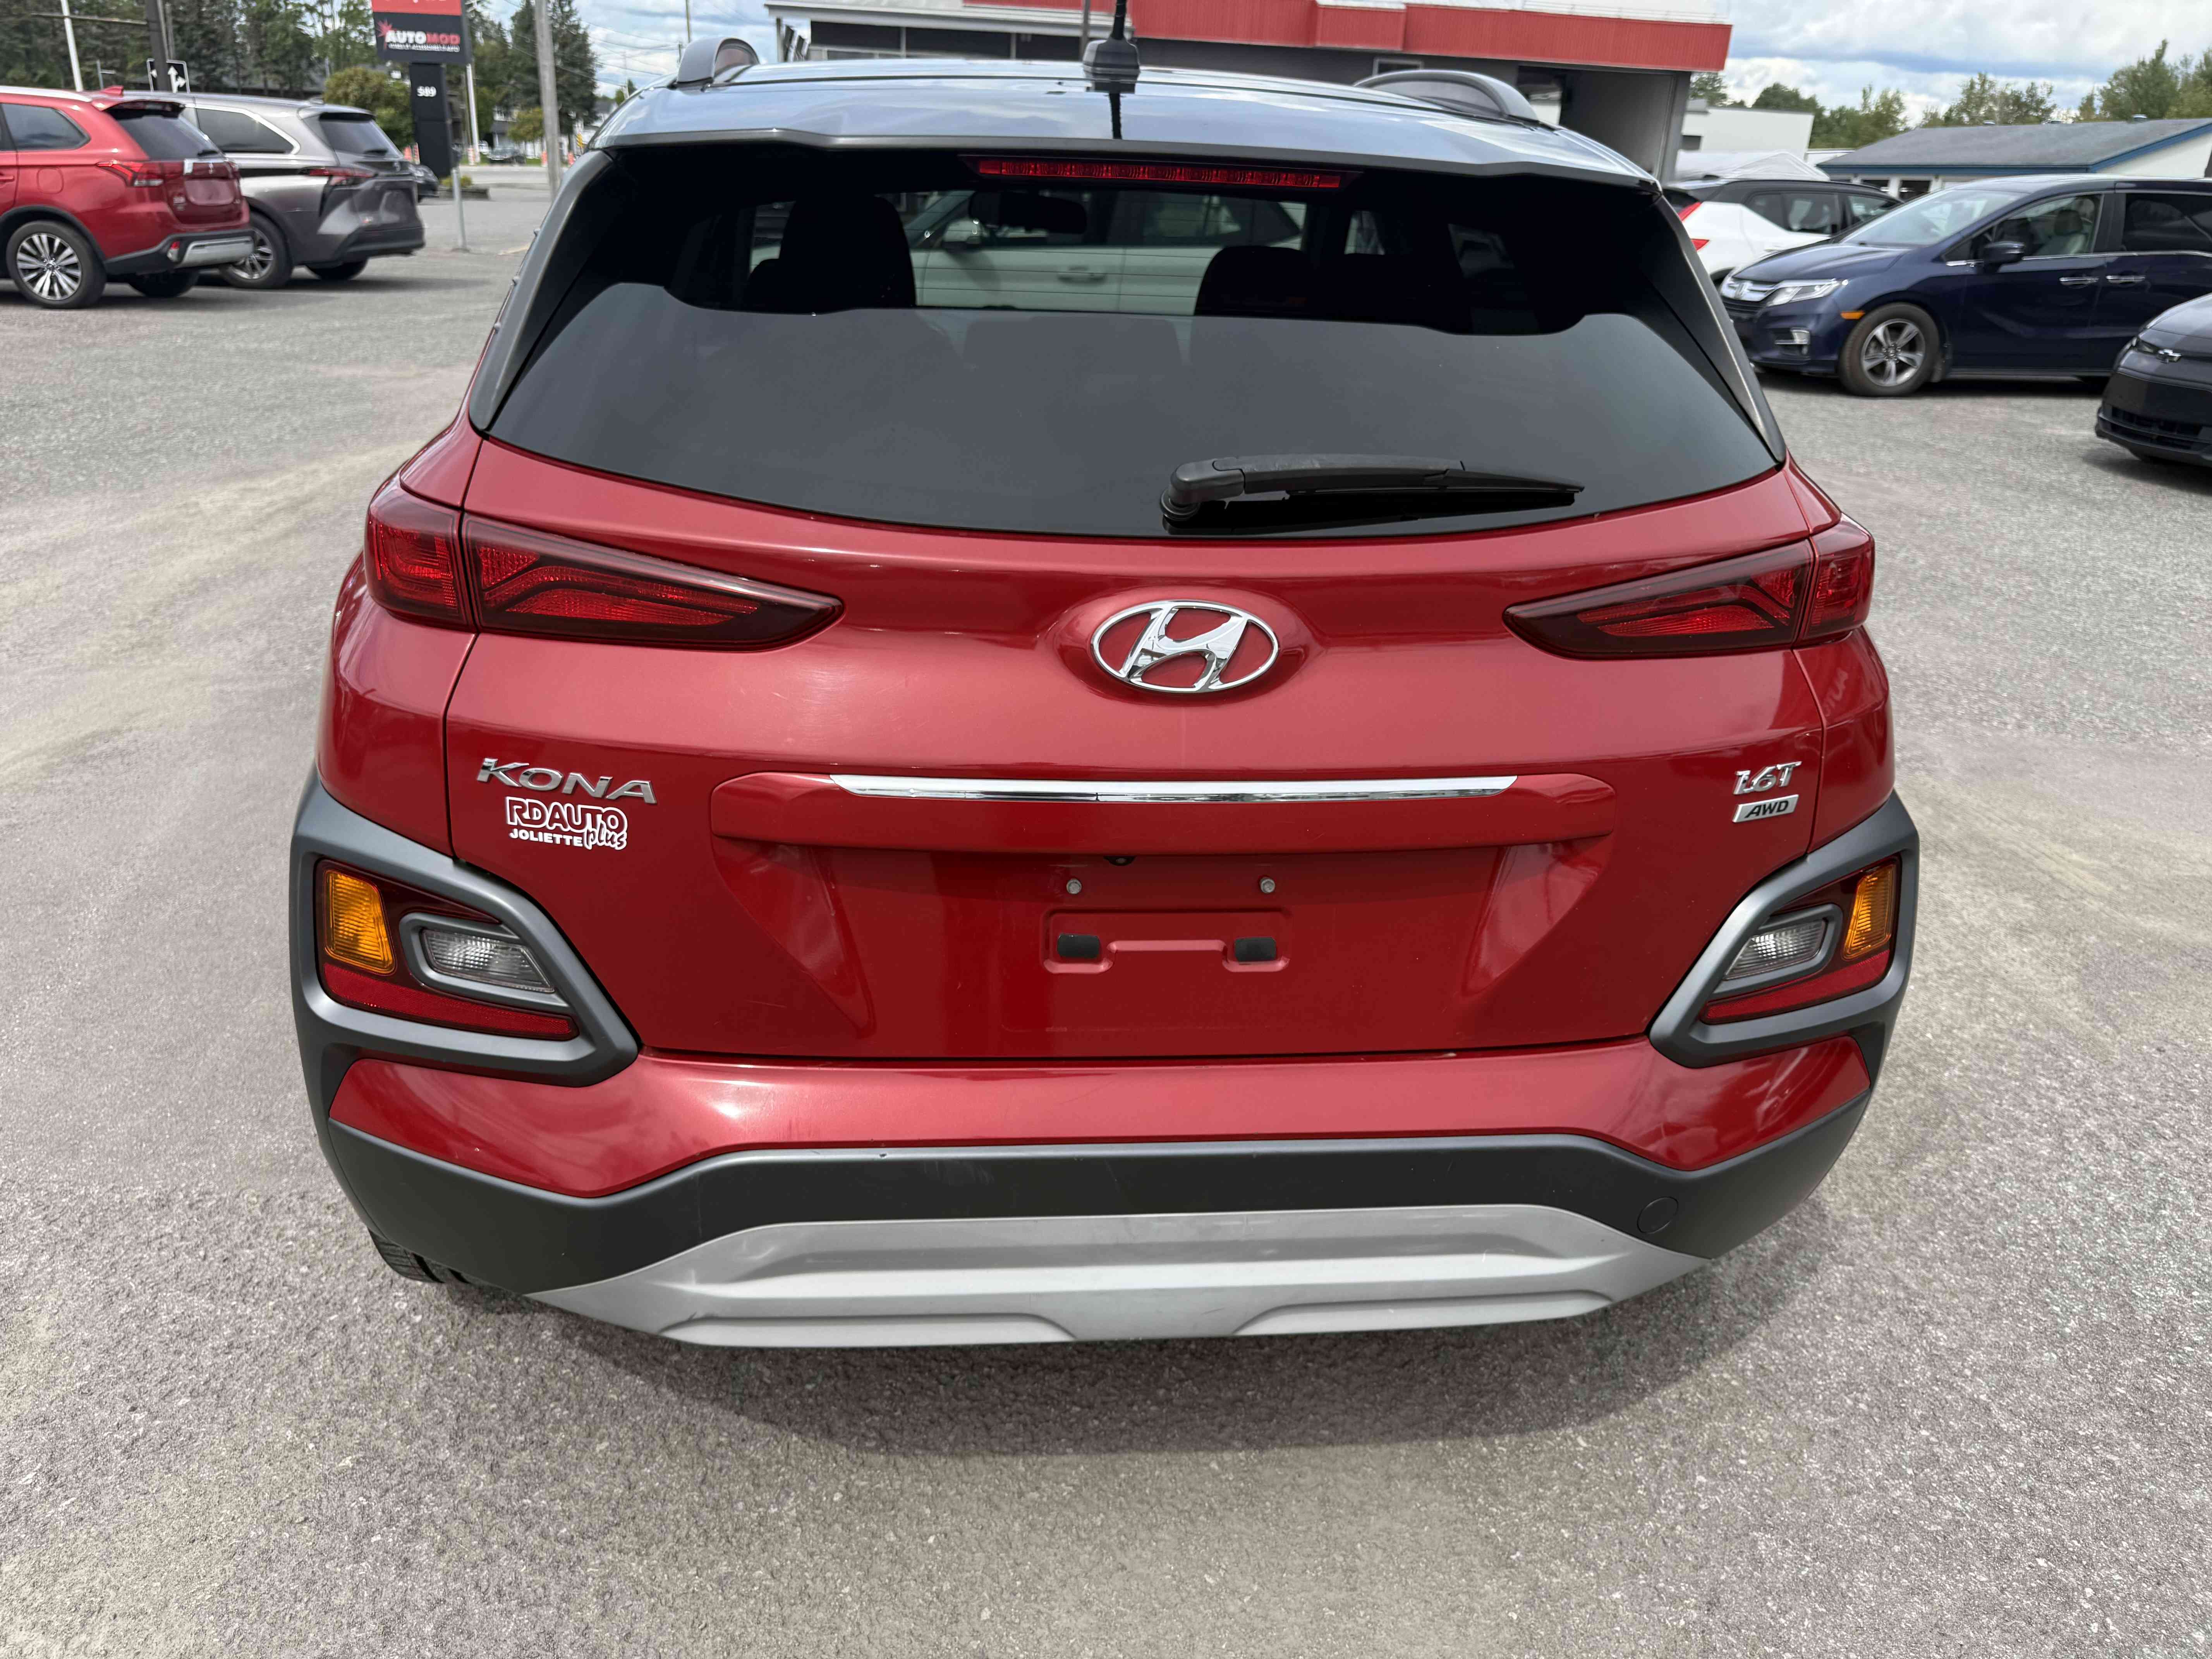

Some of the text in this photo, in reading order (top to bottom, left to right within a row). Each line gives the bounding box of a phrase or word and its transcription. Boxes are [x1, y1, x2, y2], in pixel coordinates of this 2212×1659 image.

[477, 757, 657, 804] KONA
[1733, 761, 1802, 795] 1.6T
[1745, 800, 1788, 818] AWD
[509, 822, 627, 850] JOLIETTE plus
